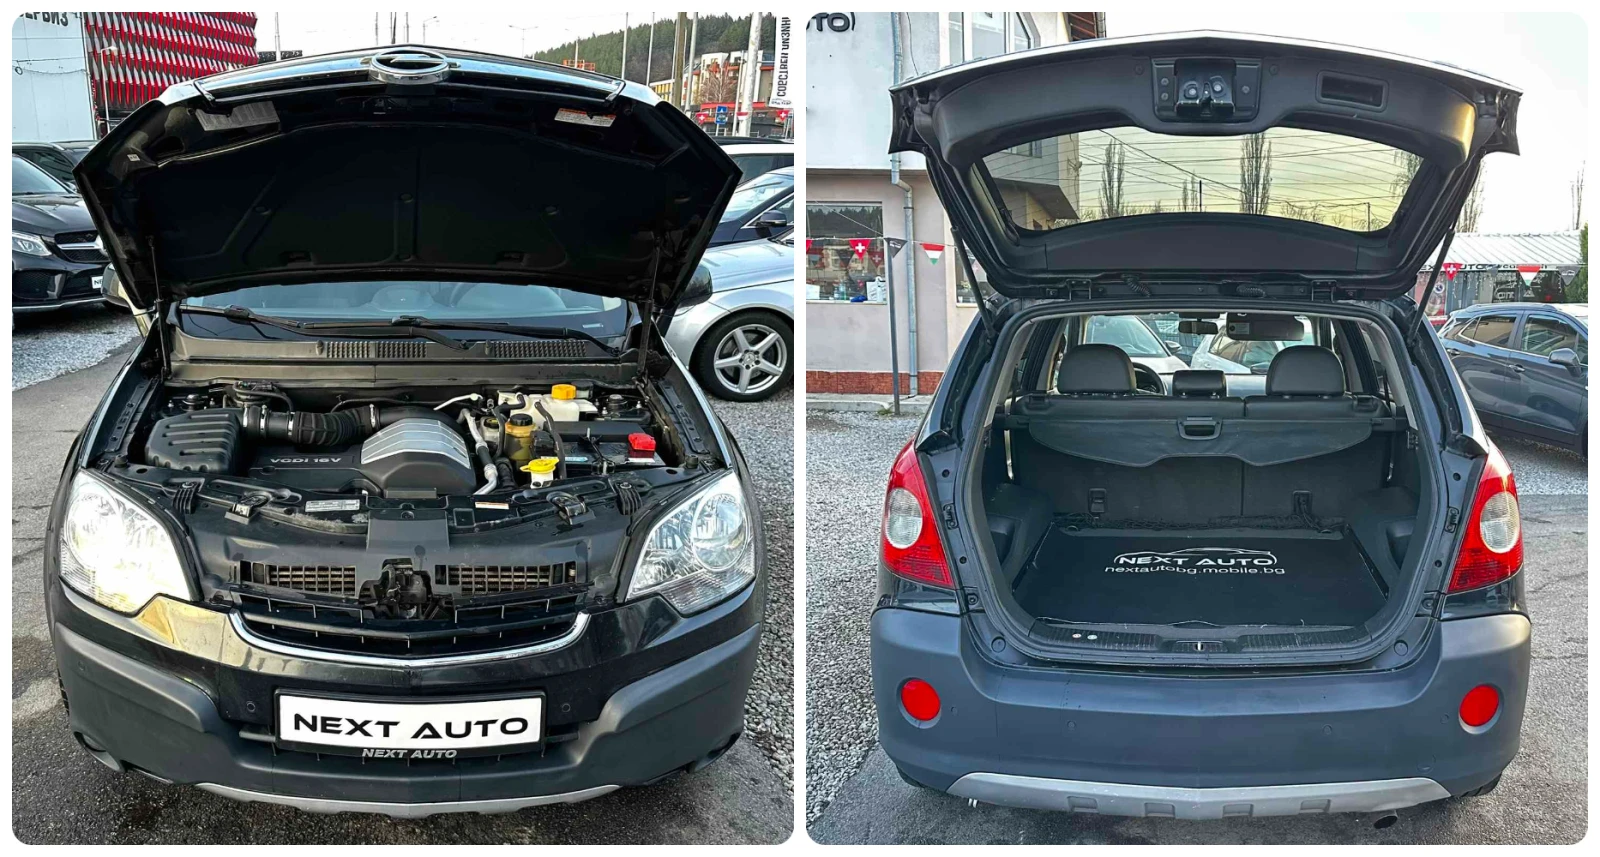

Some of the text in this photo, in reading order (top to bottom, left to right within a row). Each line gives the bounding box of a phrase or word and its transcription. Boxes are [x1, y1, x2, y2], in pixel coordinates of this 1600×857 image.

[1118, 556, 1273, 566] NEXT AUTO
[1104, 565, 1286, 575] nextautobg.mobile.bg
[294, 713, 528, 739] NEXT AUTO
[362, 748, 458, 759] NEXT AUTO
